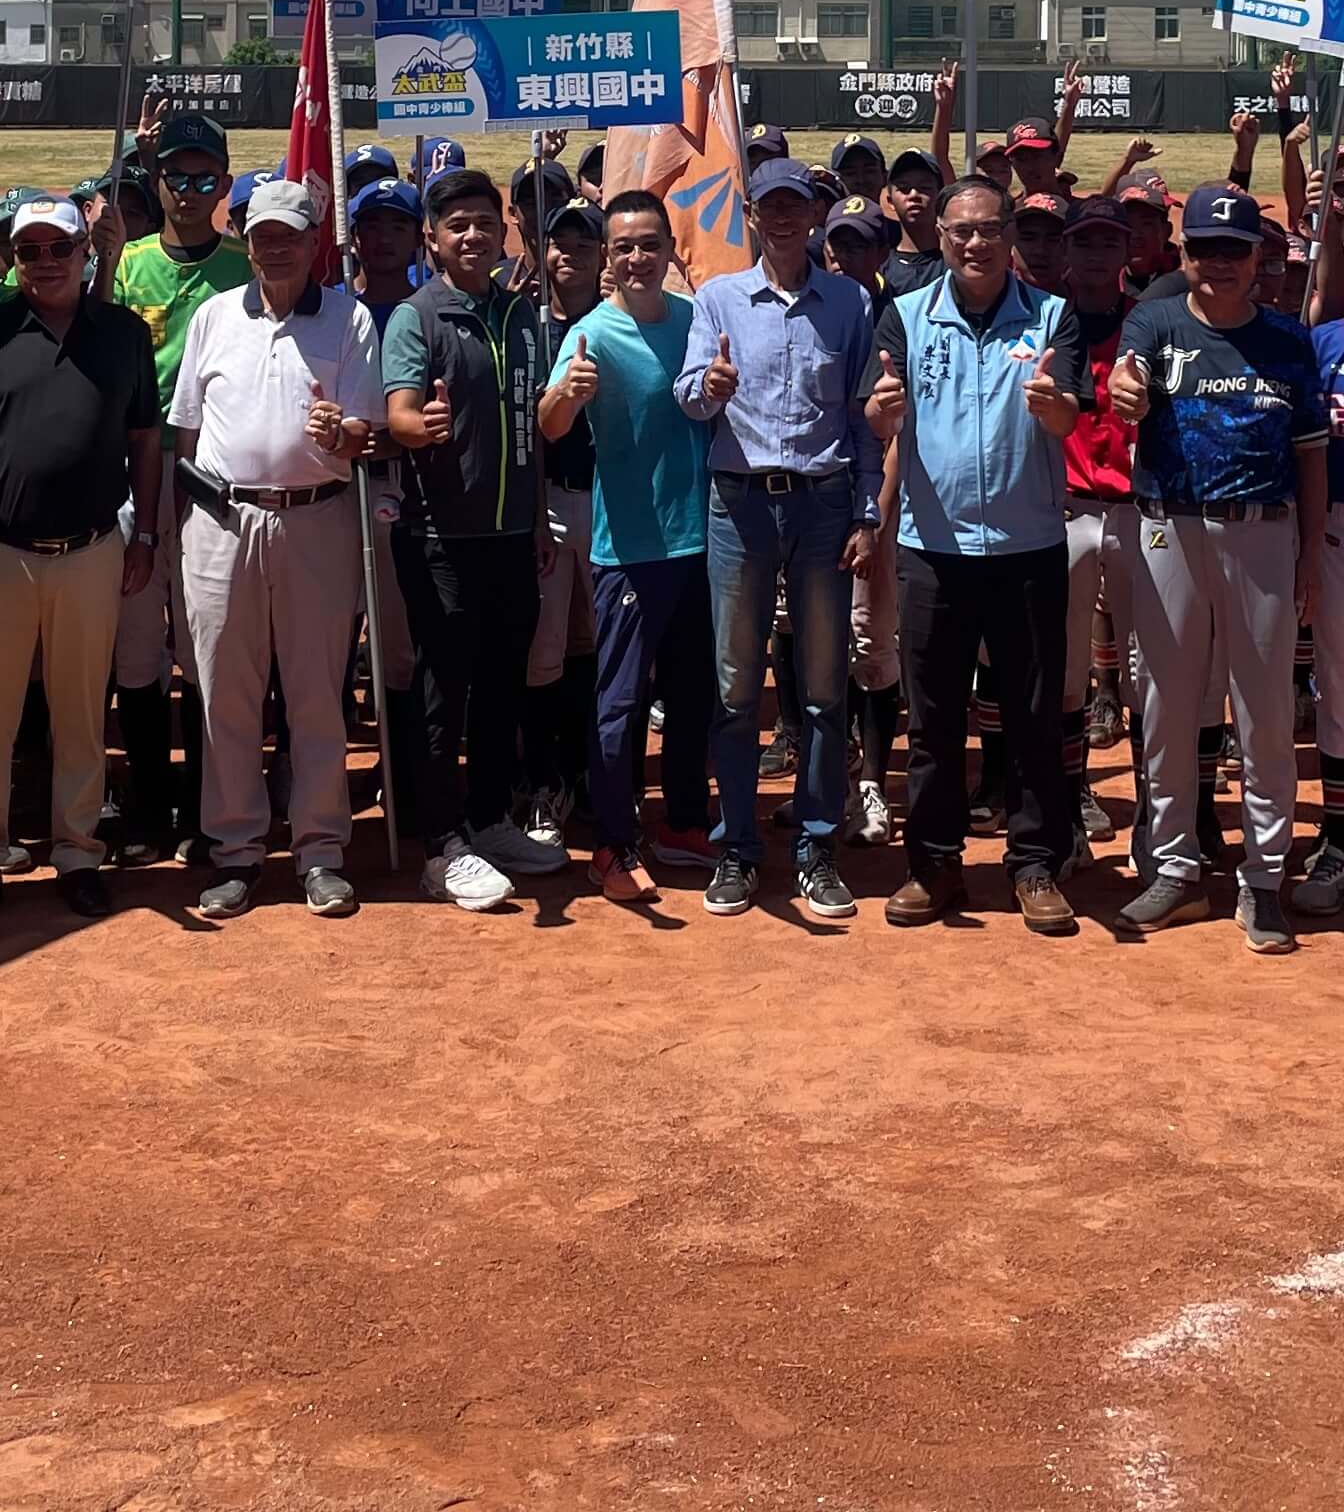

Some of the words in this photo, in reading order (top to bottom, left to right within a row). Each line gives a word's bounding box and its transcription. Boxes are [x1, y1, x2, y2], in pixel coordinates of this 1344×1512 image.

[545, 31, 633, 62] 新竹縣
[392, 71, 466, 95] 太武盃
[516, 69, 666, 111] 東興國中
[1194, 377, 1247, 396] JHONG
